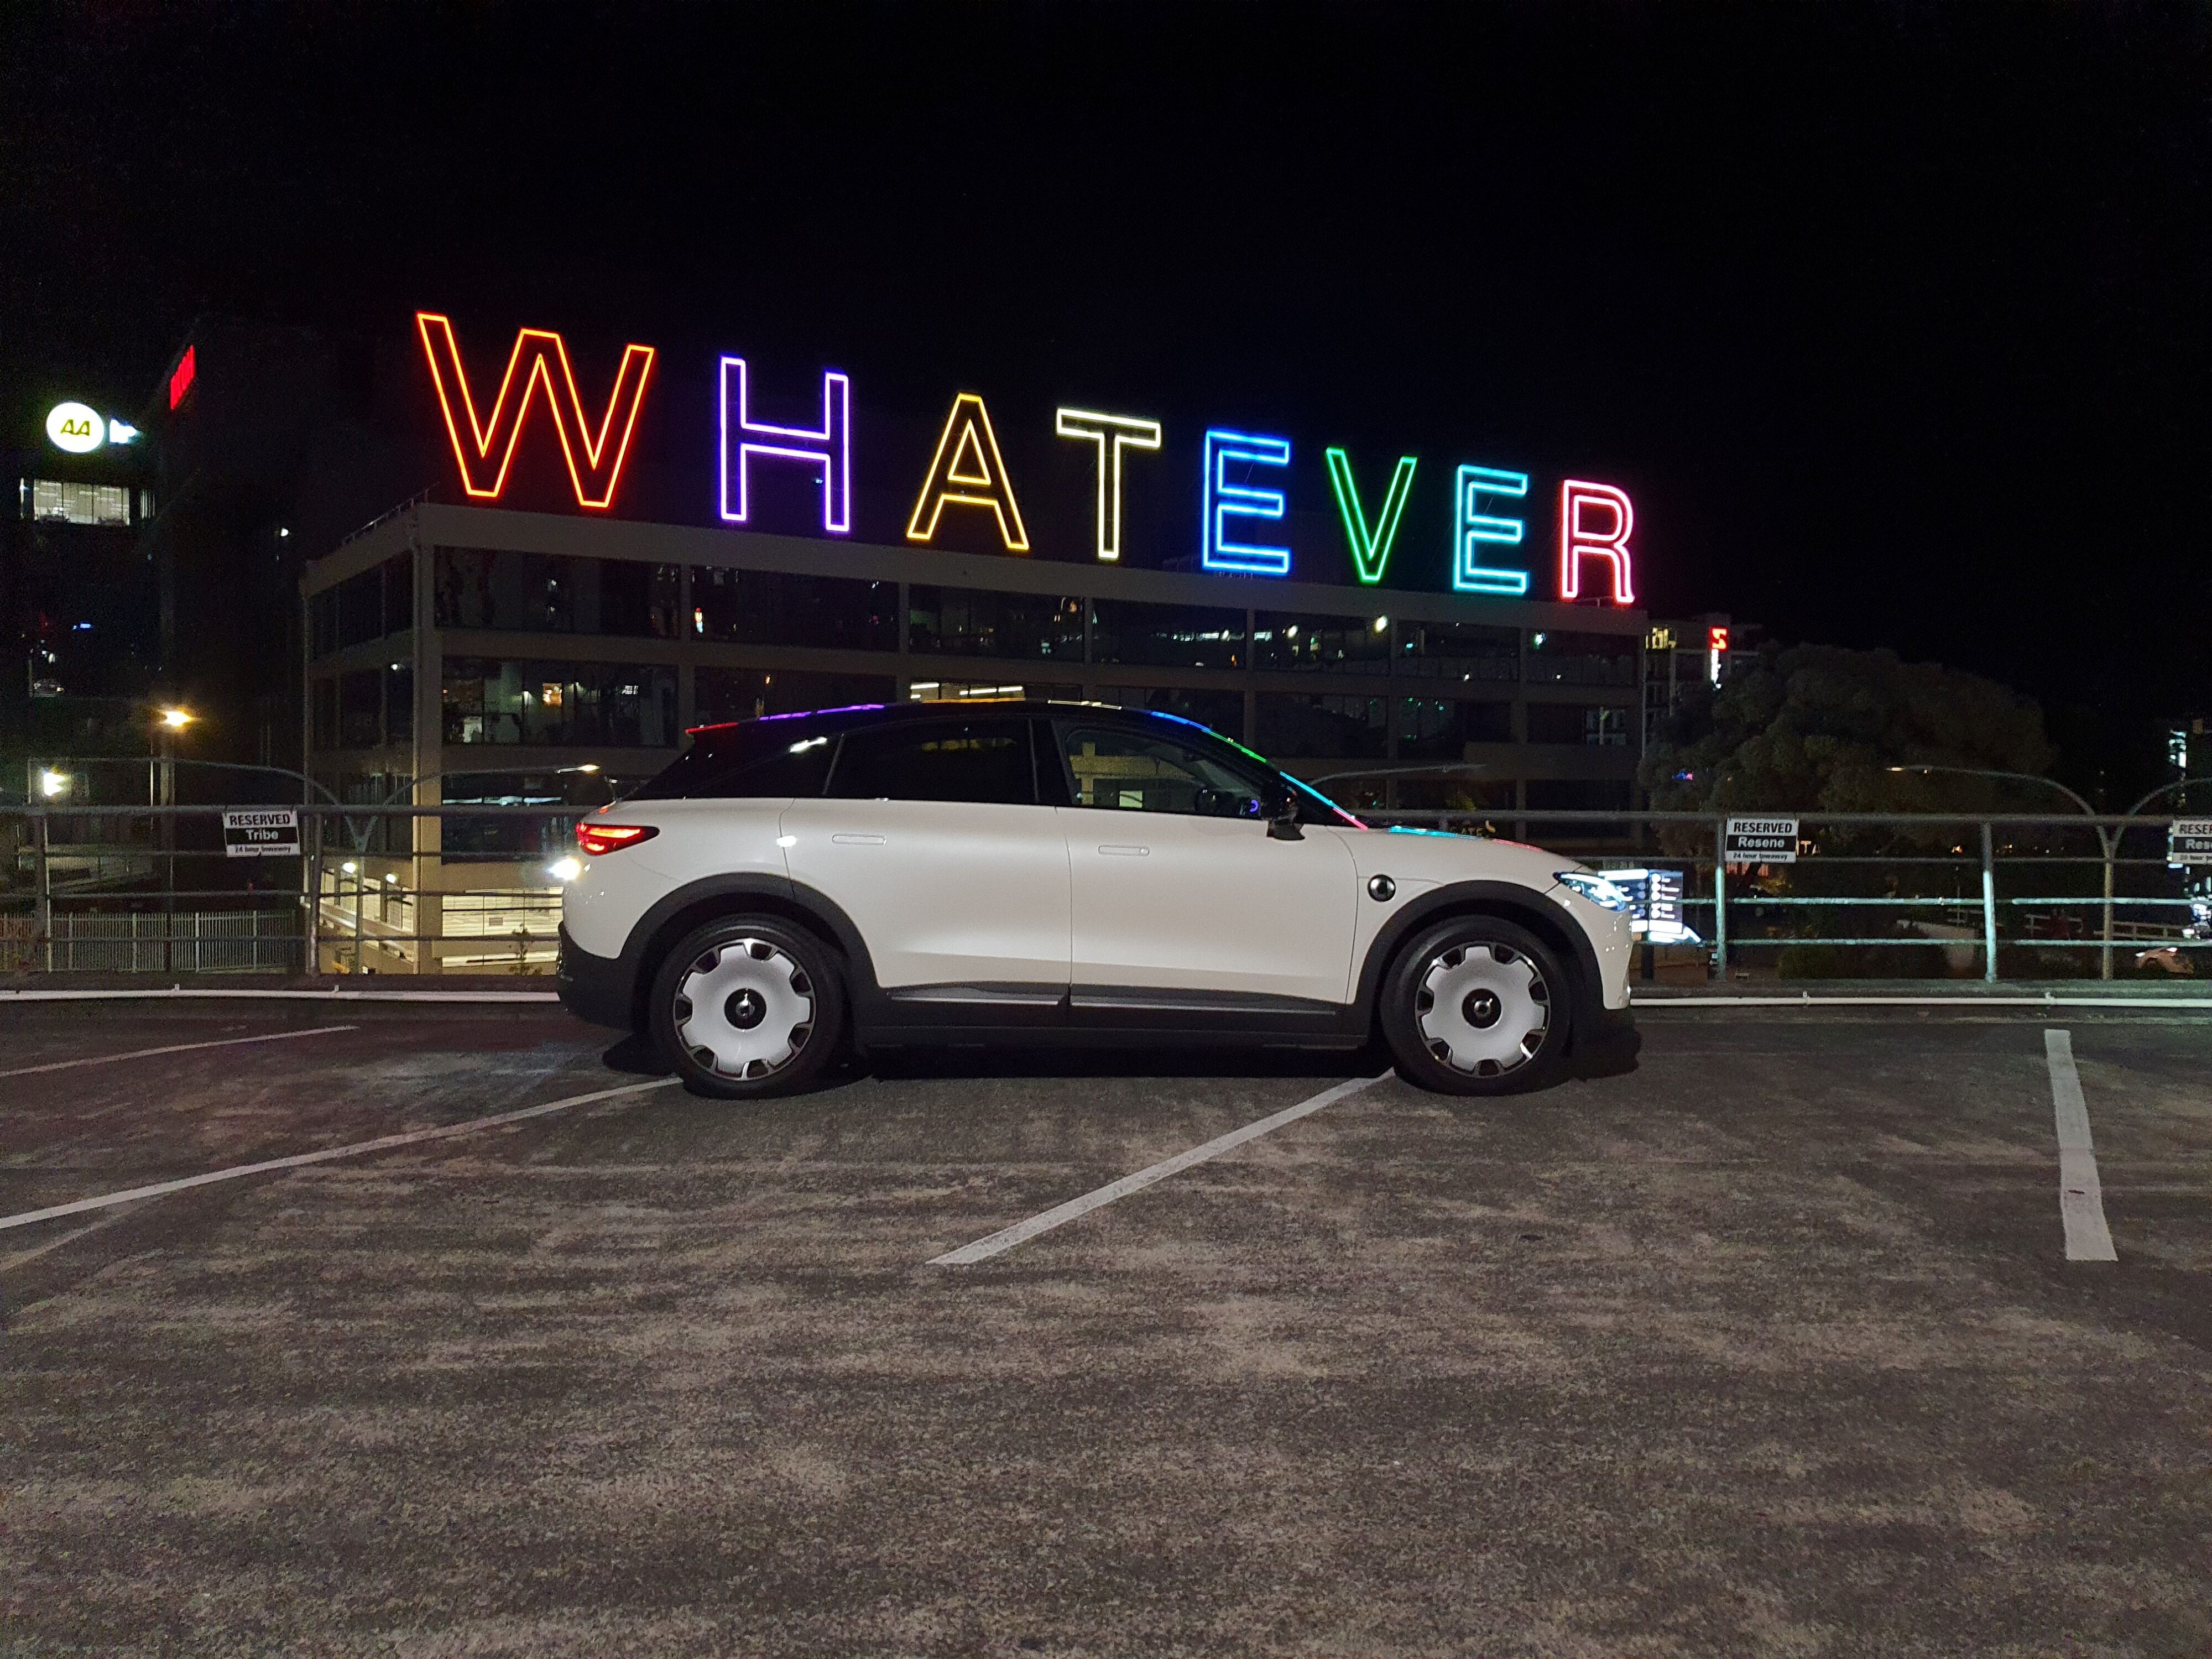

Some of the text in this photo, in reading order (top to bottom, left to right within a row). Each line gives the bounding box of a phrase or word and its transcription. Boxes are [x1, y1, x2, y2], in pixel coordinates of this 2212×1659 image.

[60, 419, 91, 436] AA
[415, 311, 1635, 604] WHATEVER
[229, 813, 291, 826] RESERVED
[1733, 822, 1792, 833] RESERVED
